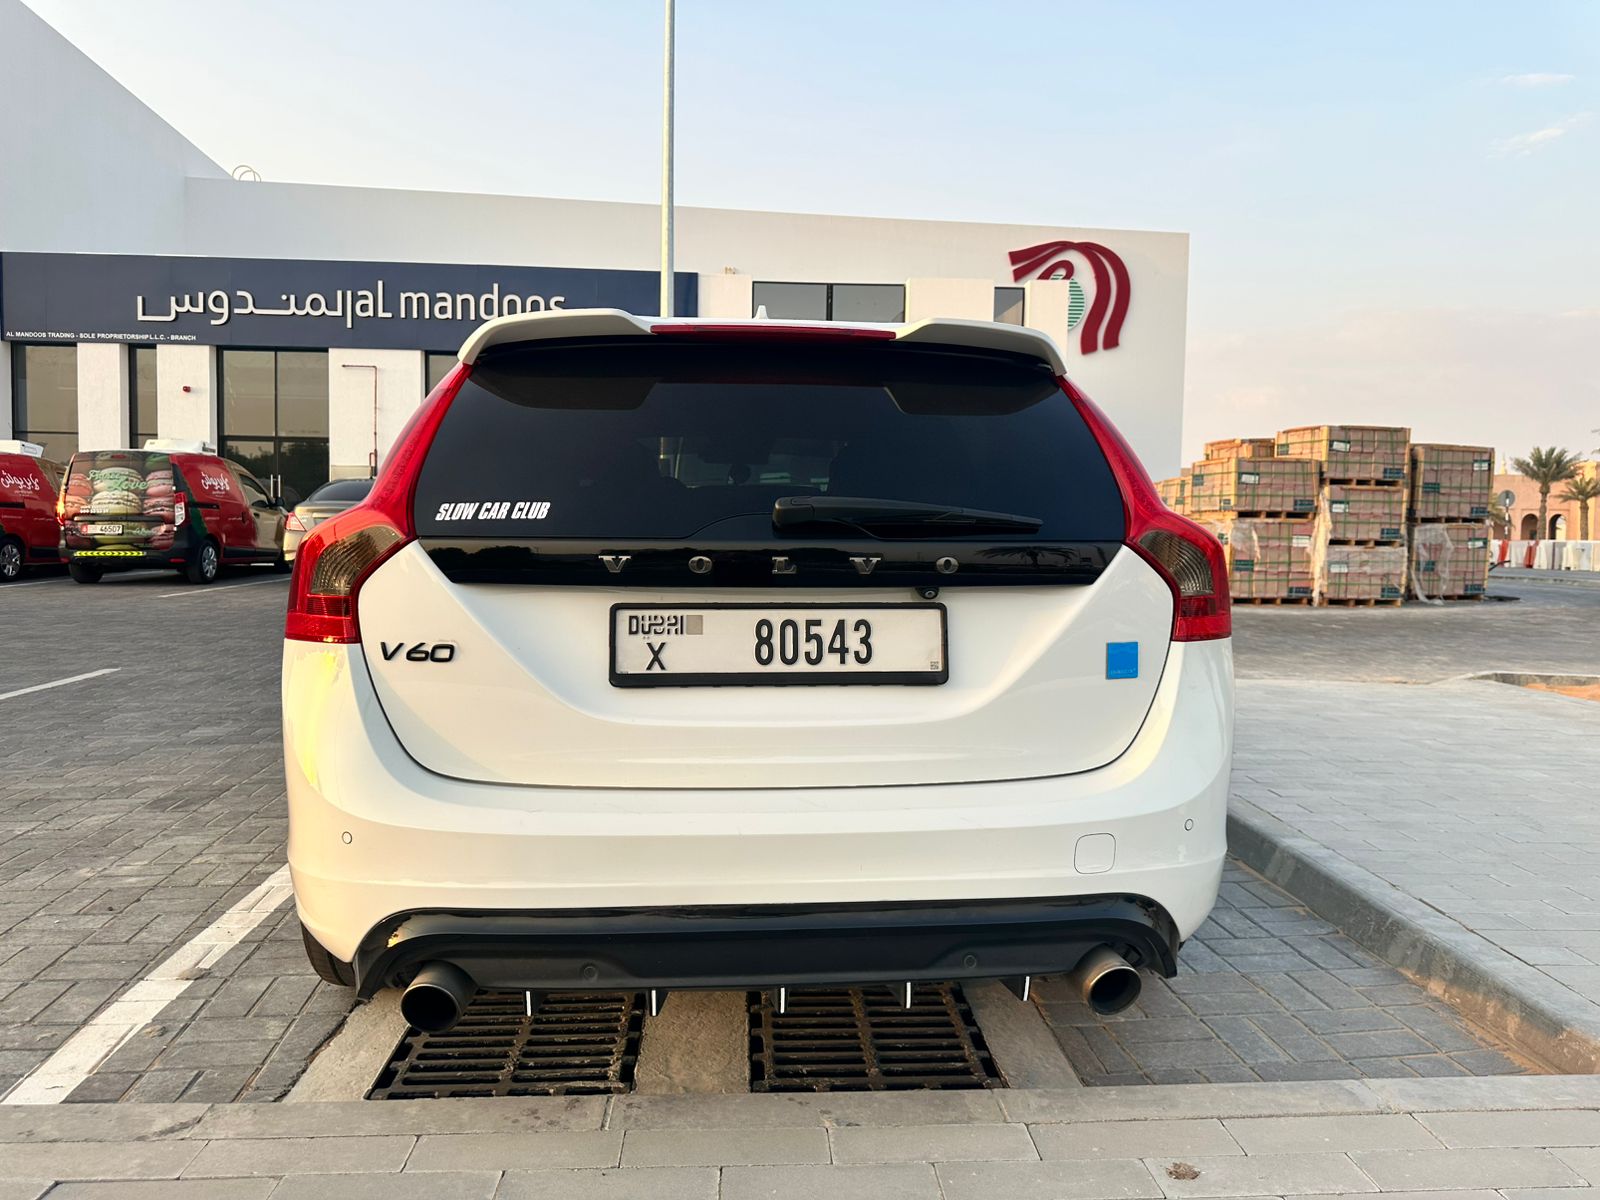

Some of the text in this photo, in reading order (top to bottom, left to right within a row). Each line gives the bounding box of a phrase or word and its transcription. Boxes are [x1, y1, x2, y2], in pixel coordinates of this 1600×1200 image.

[136, 289, 353, 329] المندوس
[96, 332, 149, 340] PROPRIETORSHIP
[435, 501, 551, 521] SLOW CAR CLUB
[100, 525, 121, 533] 46507
[598, 554, 960, 575] VOLVO
[380, 641, 455, 663] V60
[754, 618, 873, 666] 80543
[645, 642, 666, 671] X
